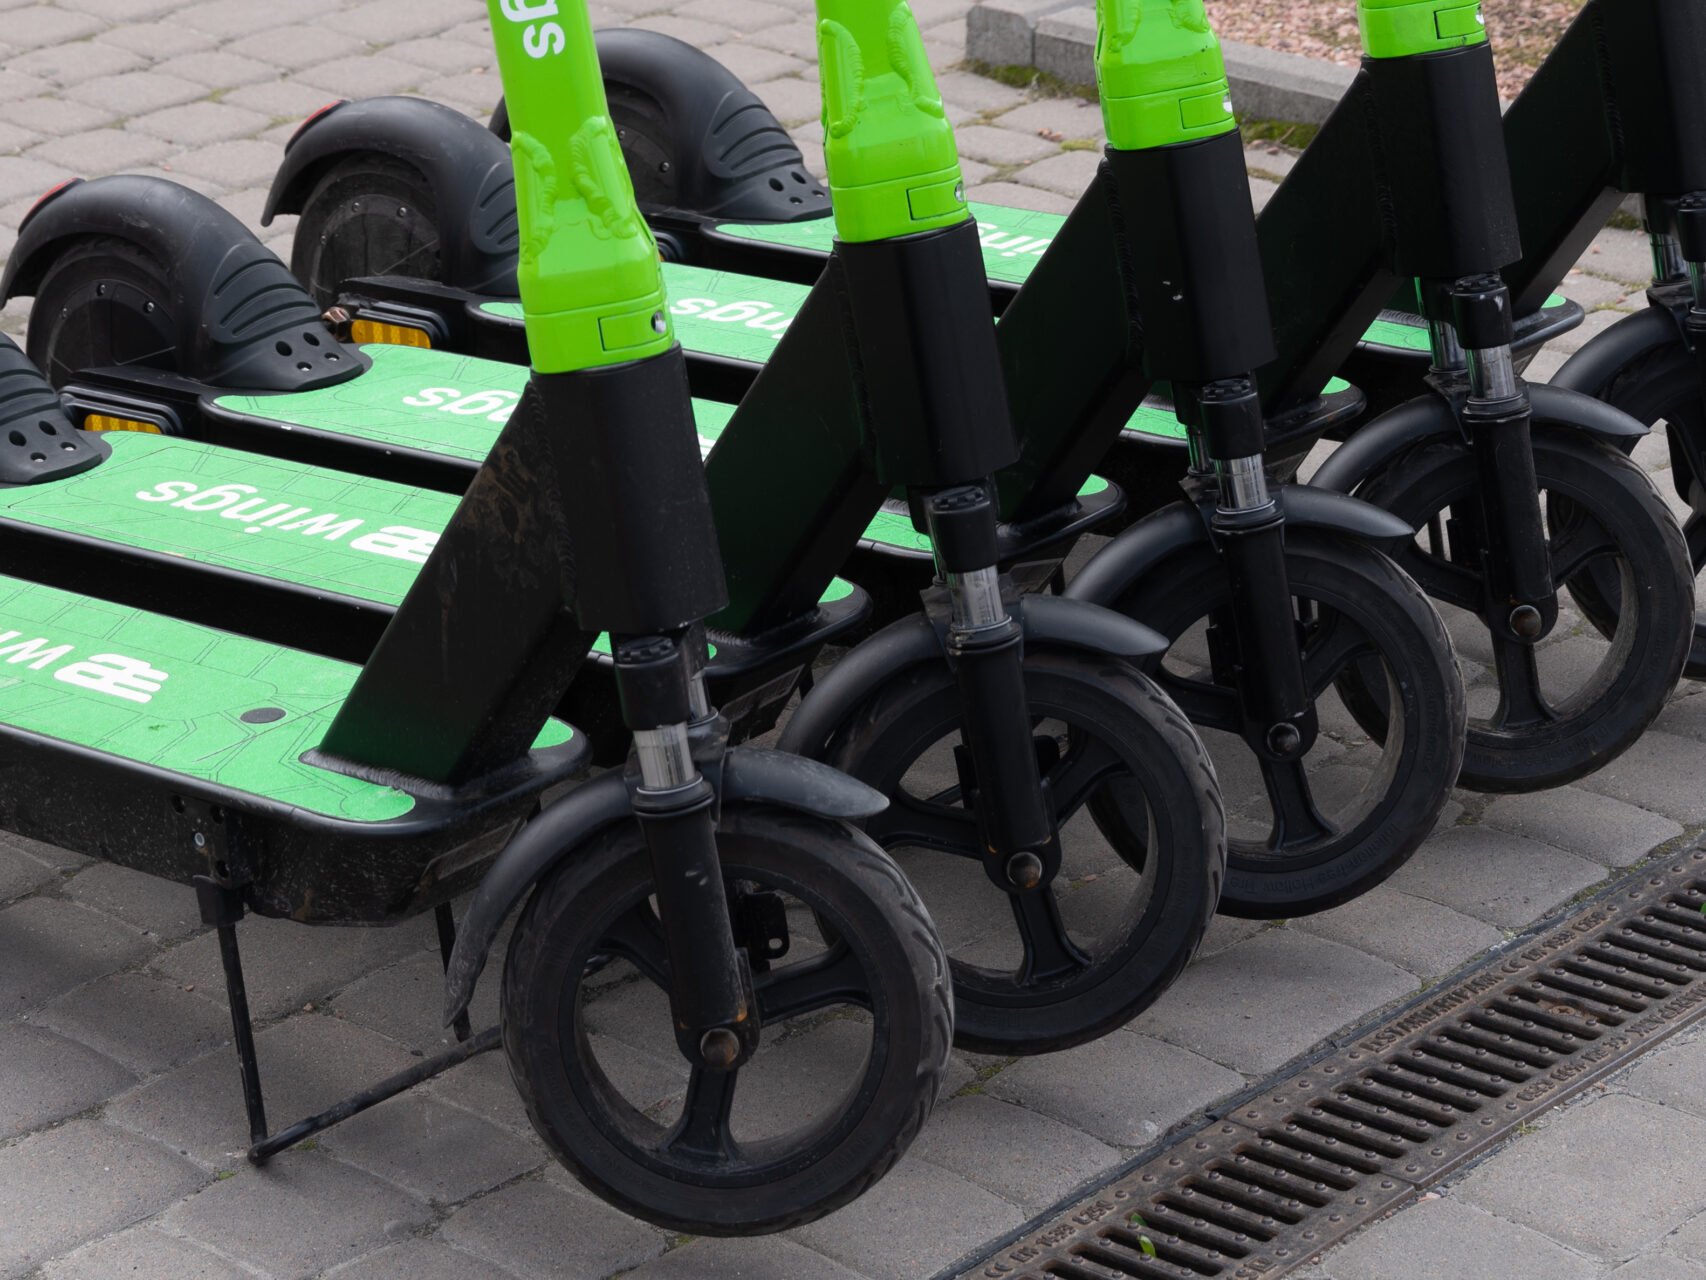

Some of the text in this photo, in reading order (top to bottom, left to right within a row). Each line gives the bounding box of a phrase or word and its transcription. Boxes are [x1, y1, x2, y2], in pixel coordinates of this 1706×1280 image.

[670, 298, 795, 334] ngs
[136, 480, 348, 541] wings
[1263, 878, 1314, 894] Hollow
